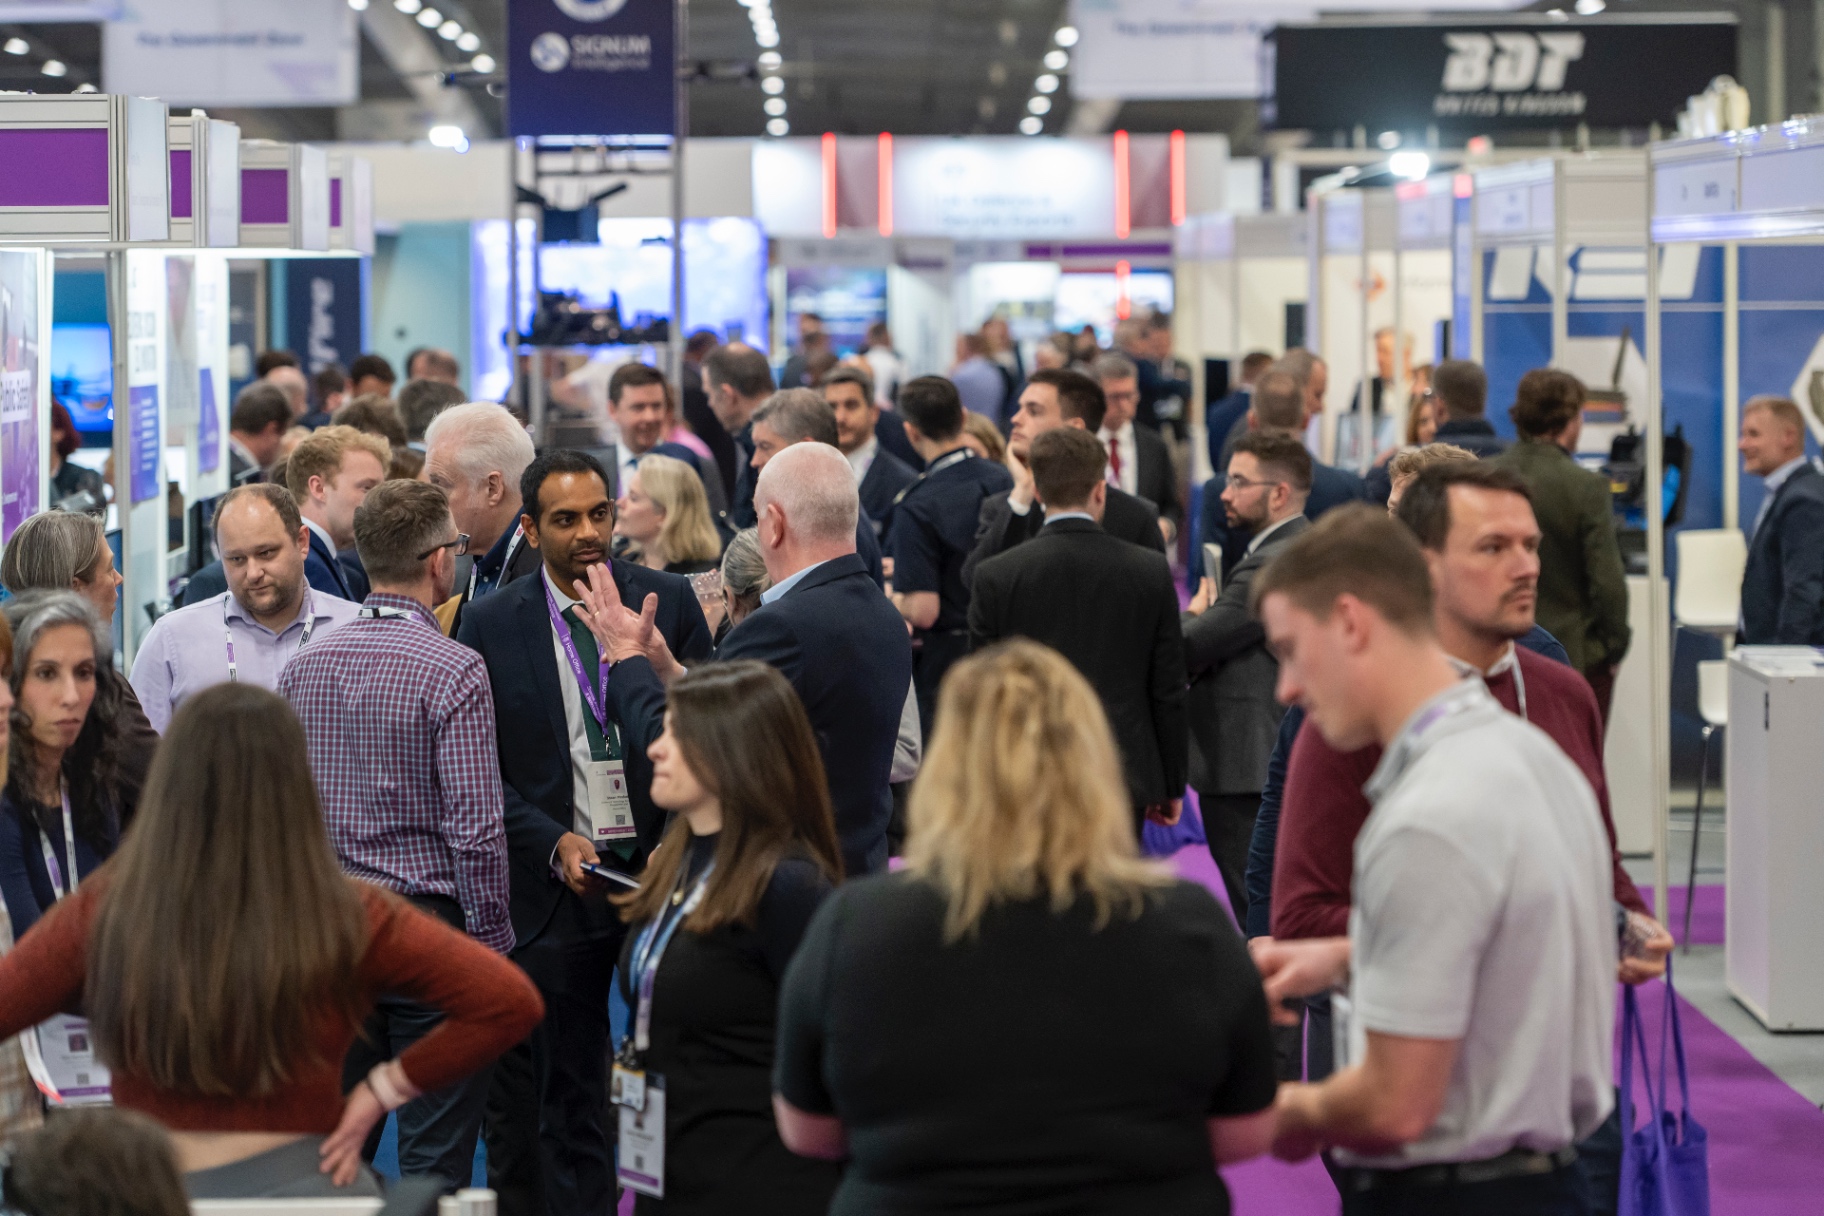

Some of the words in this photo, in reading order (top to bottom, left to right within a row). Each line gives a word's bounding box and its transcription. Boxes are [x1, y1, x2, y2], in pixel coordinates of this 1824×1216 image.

[570, 34, 651, 54] SIGNUM
[1442, 31, 1585, 91] BDT
[565, 642, 575, 660] Home
[572, 658, 582, 675] Office
